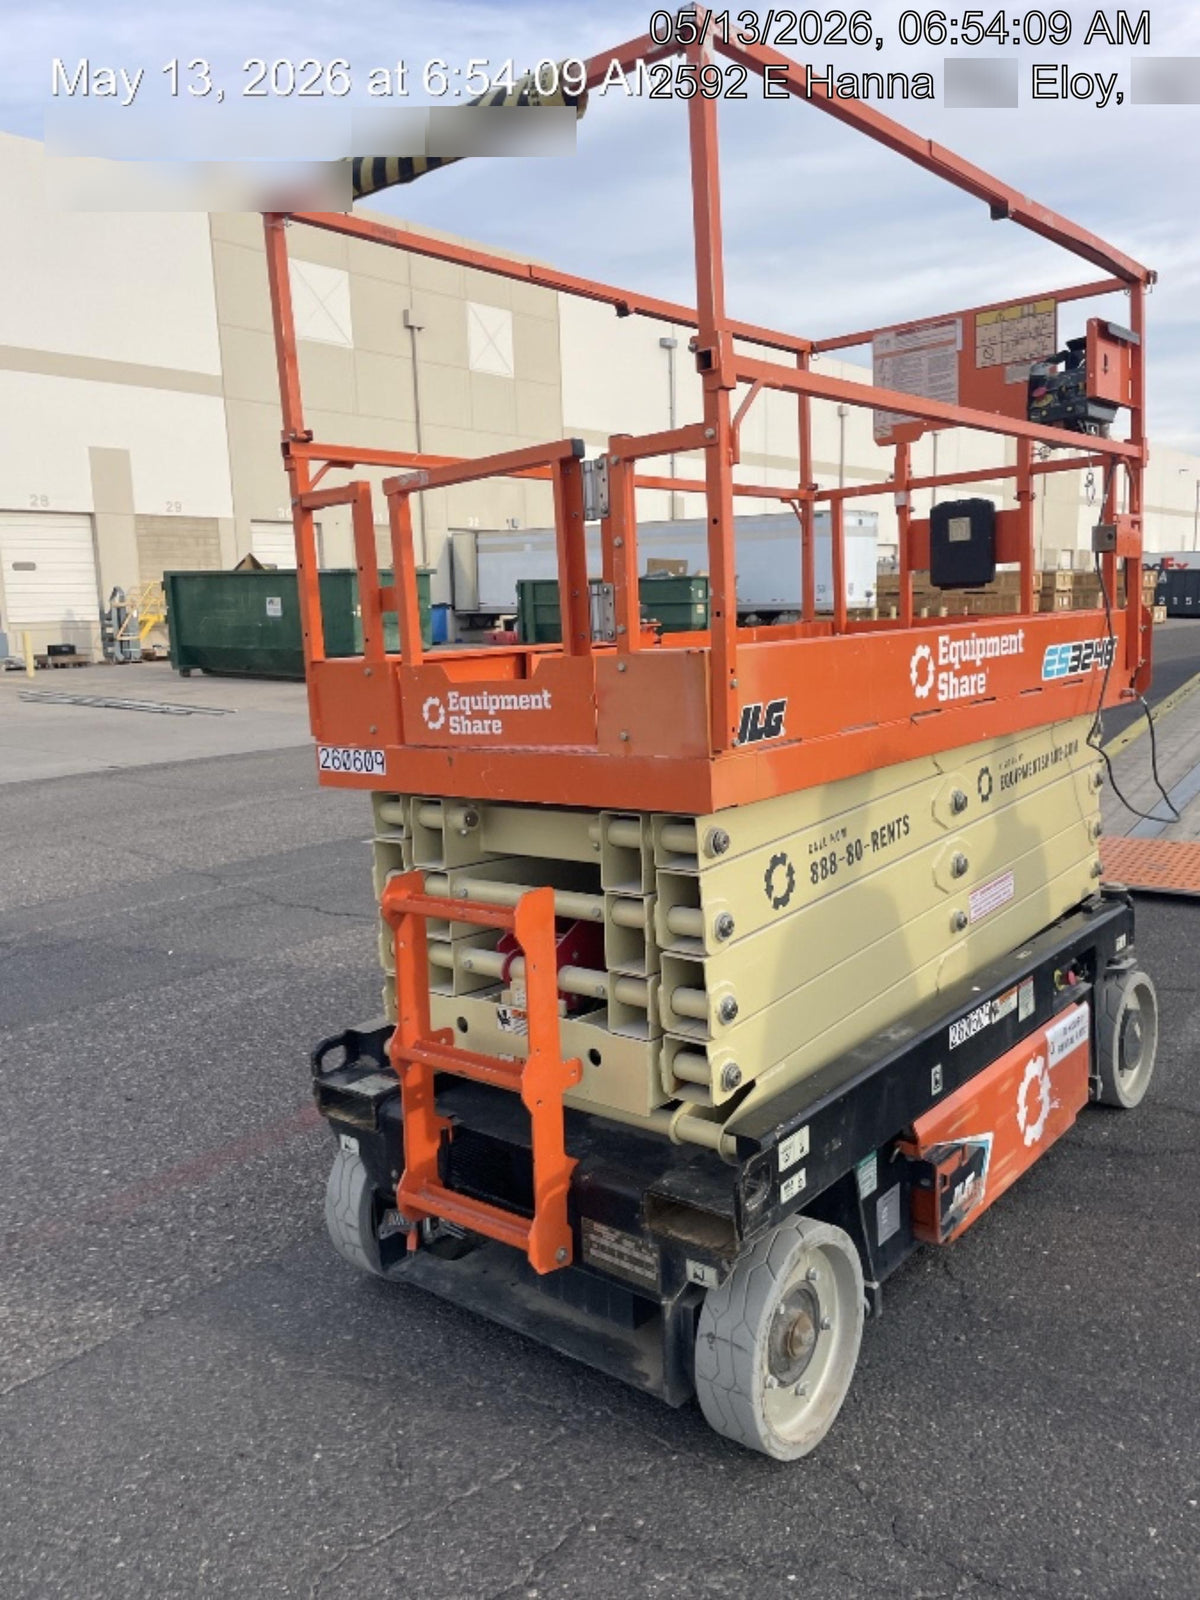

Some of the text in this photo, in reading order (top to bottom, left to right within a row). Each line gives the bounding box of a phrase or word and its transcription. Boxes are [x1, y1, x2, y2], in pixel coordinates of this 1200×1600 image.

[937, 628, 1025, 670] Equipment
[937, 670, 986, 702] Share
[447, 689, 552, 715] Equipment
[448, 715, 503, 735] Share
[319, 747, 385, 773] 260609
[809, 813, 911, 885] 888-80-RENTS
